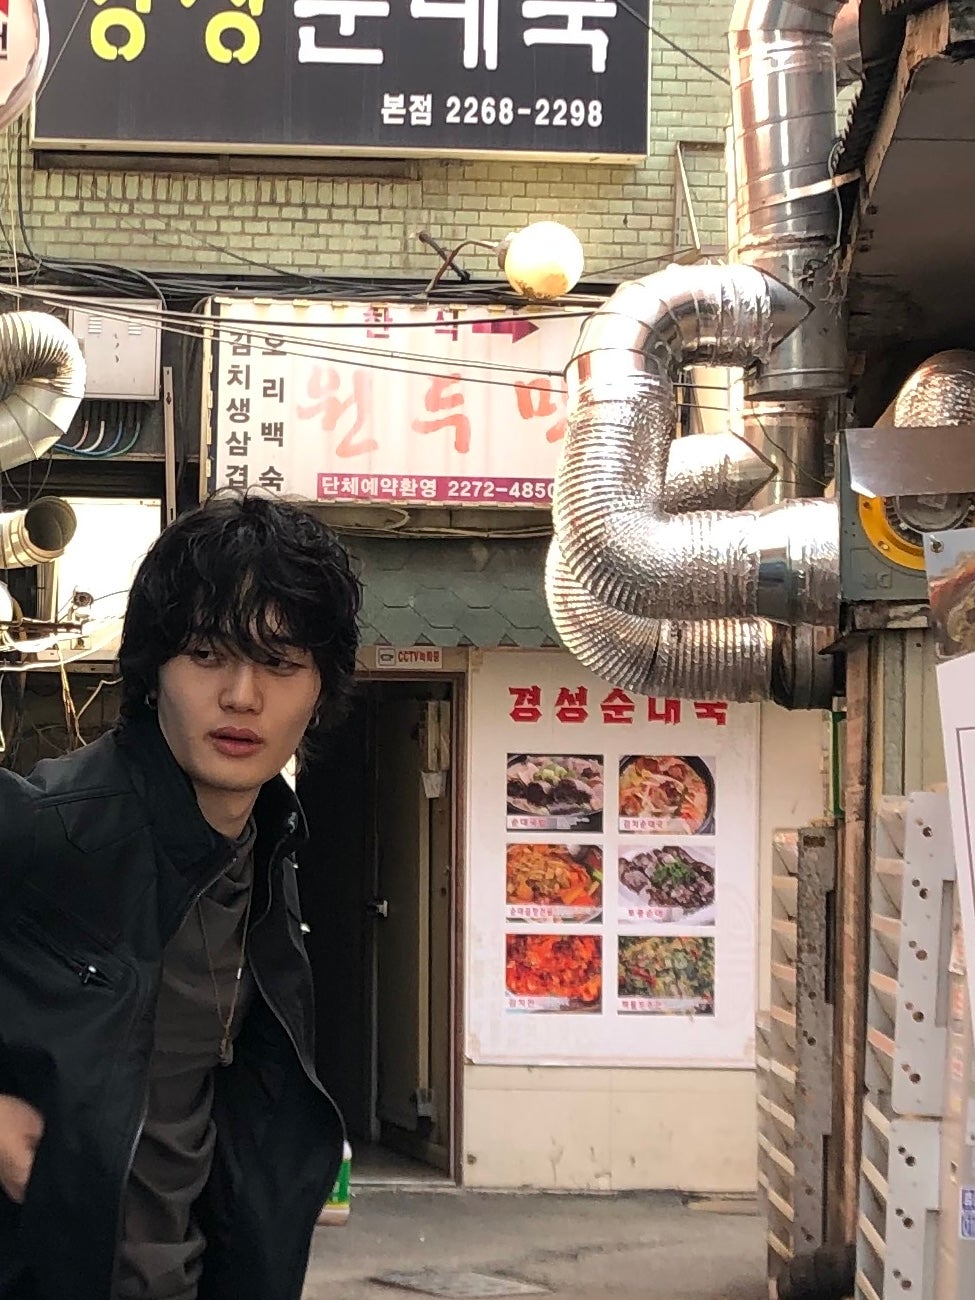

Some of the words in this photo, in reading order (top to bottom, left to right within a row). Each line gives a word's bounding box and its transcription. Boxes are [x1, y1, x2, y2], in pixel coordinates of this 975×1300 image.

[381, 93, 432, 126] 본점
[446, 96, 603, 127] 2268-2298
[321, 477, 438, 497] 단체예약환영
